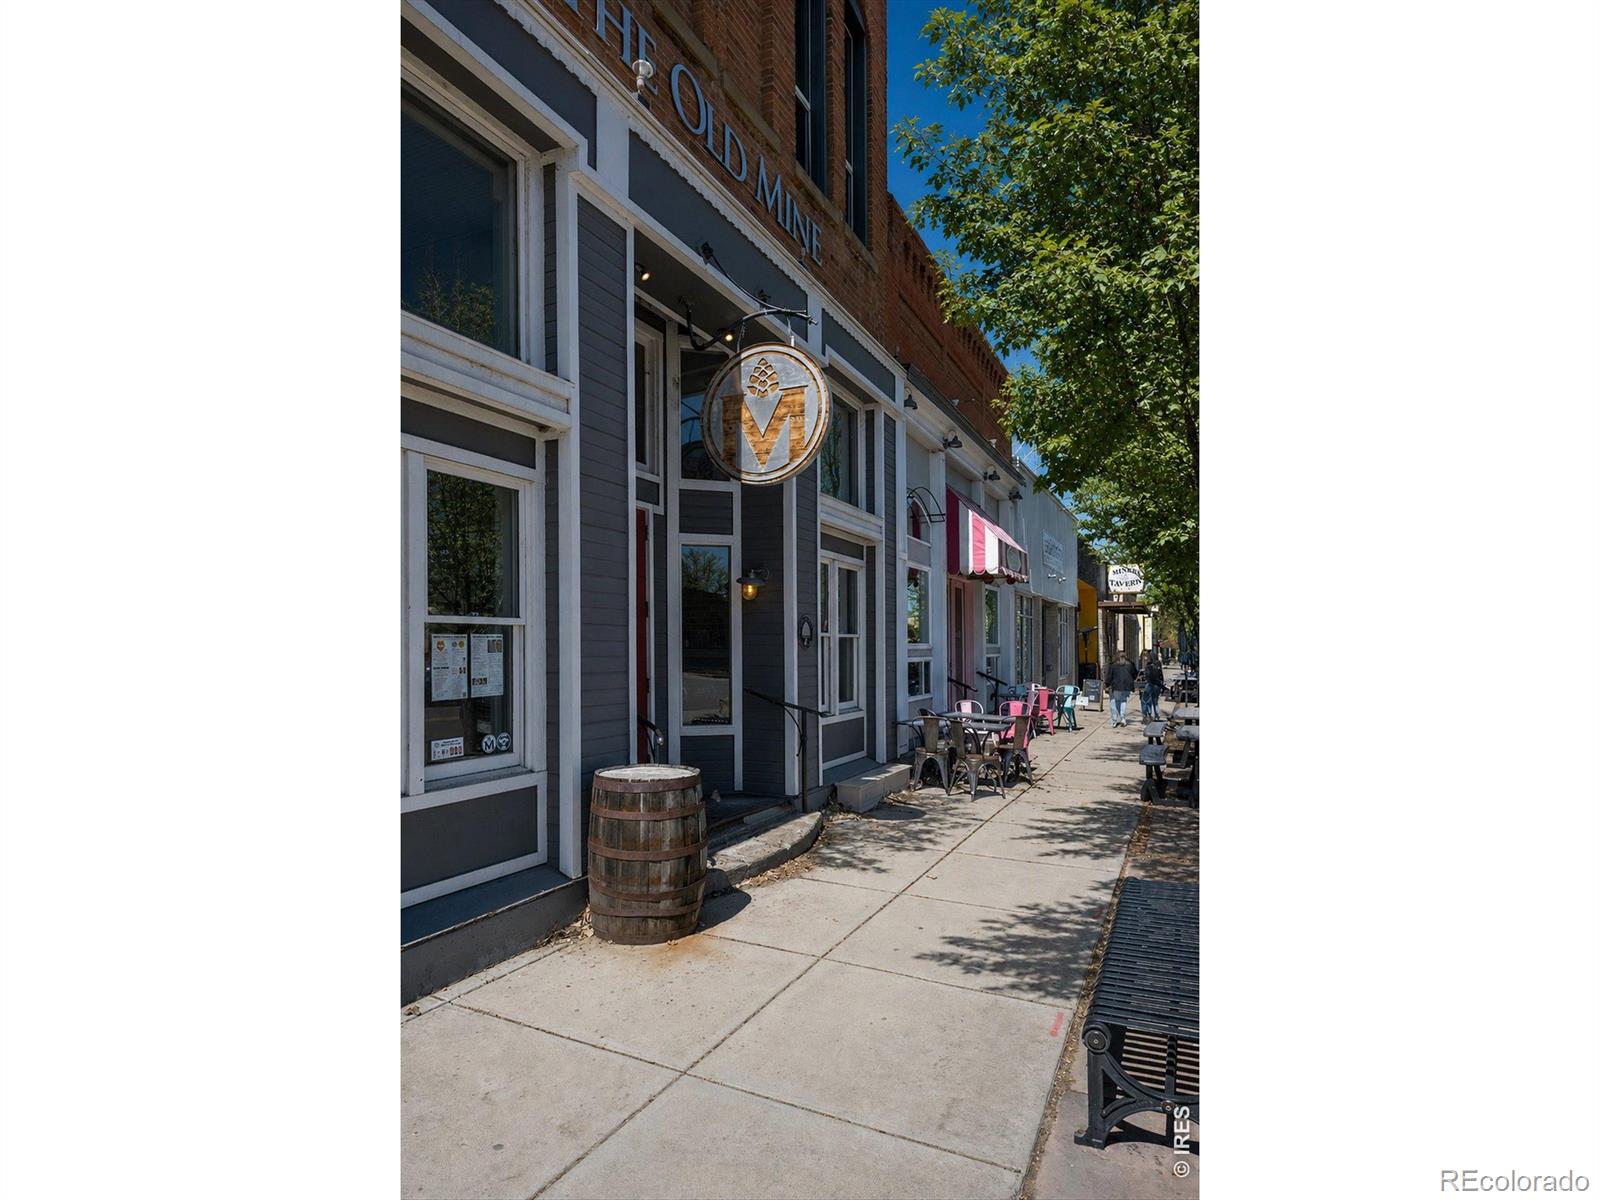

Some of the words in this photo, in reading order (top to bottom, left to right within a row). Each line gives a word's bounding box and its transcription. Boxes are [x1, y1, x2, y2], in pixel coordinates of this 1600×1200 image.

[564, 0, 658, 96] HE
[671, 63, 747, 182] OLD
[755, 154, 823, 267] MINE
[1109, 579, 1142, 587] TAVERN
